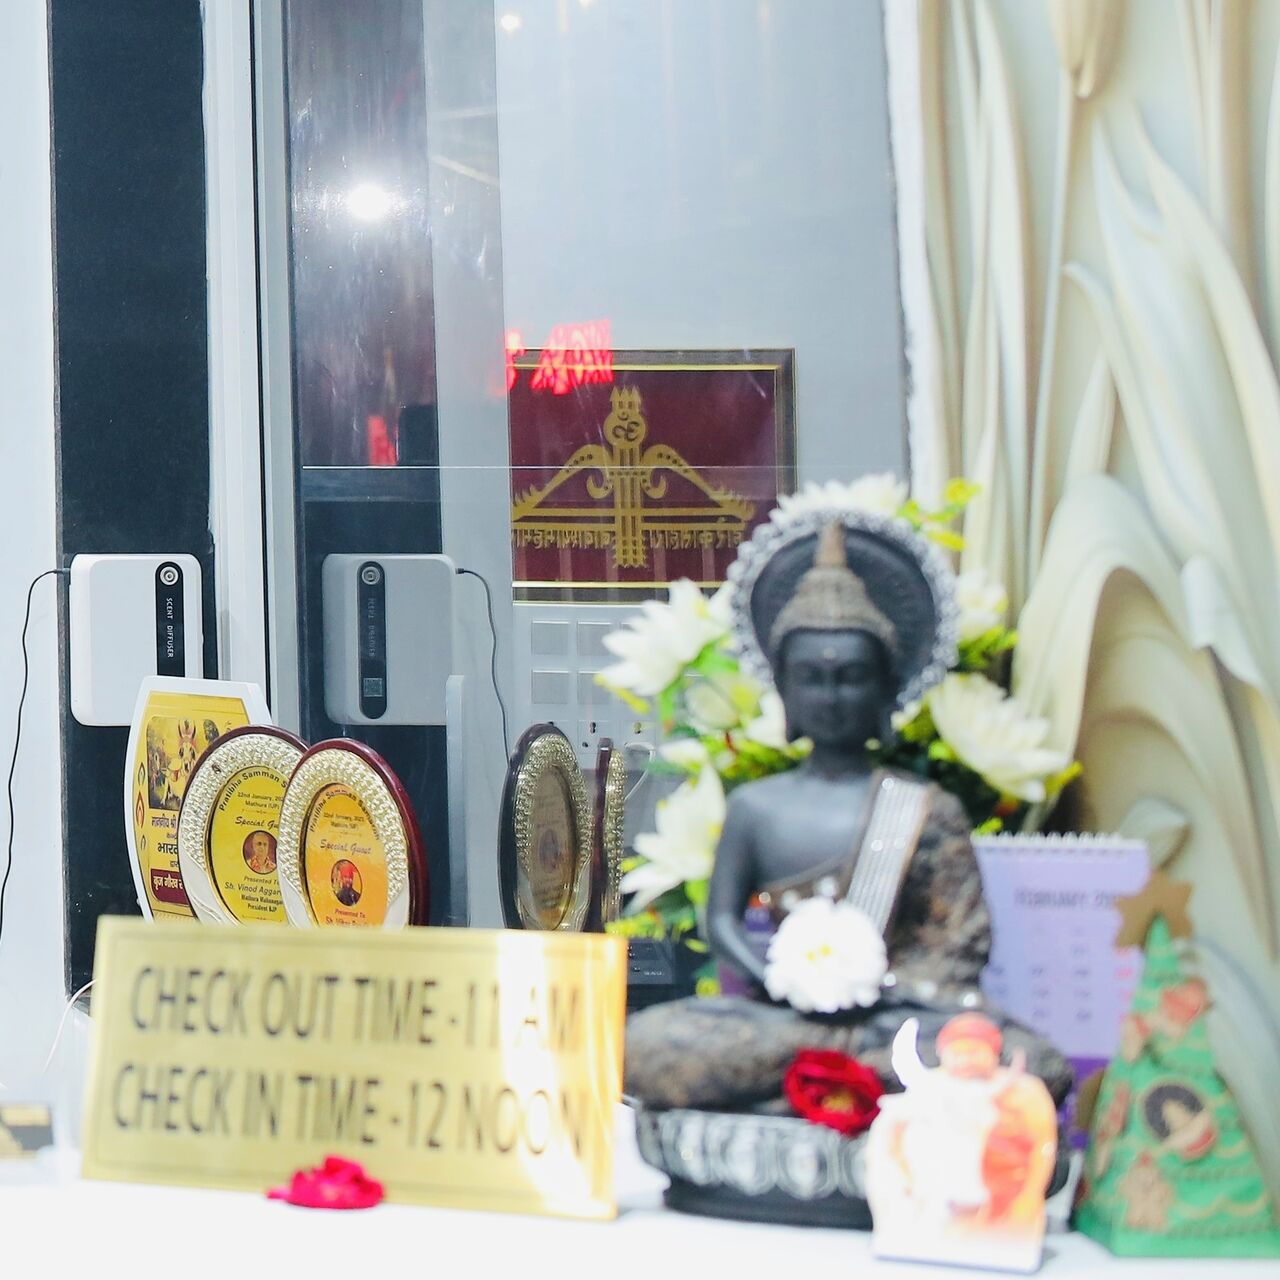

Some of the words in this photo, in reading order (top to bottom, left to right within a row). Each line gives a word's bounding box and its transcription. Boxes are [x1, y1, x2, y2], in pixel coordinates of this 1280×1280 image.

[166, 597, 174, 619] SCENT
[166, 625, 174, 658] DIFFUSER
[219, 779, 242, 811] Pratibha
[242, 771, 280, 782] Samman
[235, 816, 265, 827] Special
[320, 838, 348, 852] Special
[237, 883, 258, 893] Vinod
[131, 967, 251, 1034] CHECK
[260, 972, 339, 1041] OUT
[353, 975, 437, 1045] TIME
[112, 1062, 234, 1136] CHECK
[242, 1069, 284, 1138] IN
[296, 1074, 381, 1144] TIME
